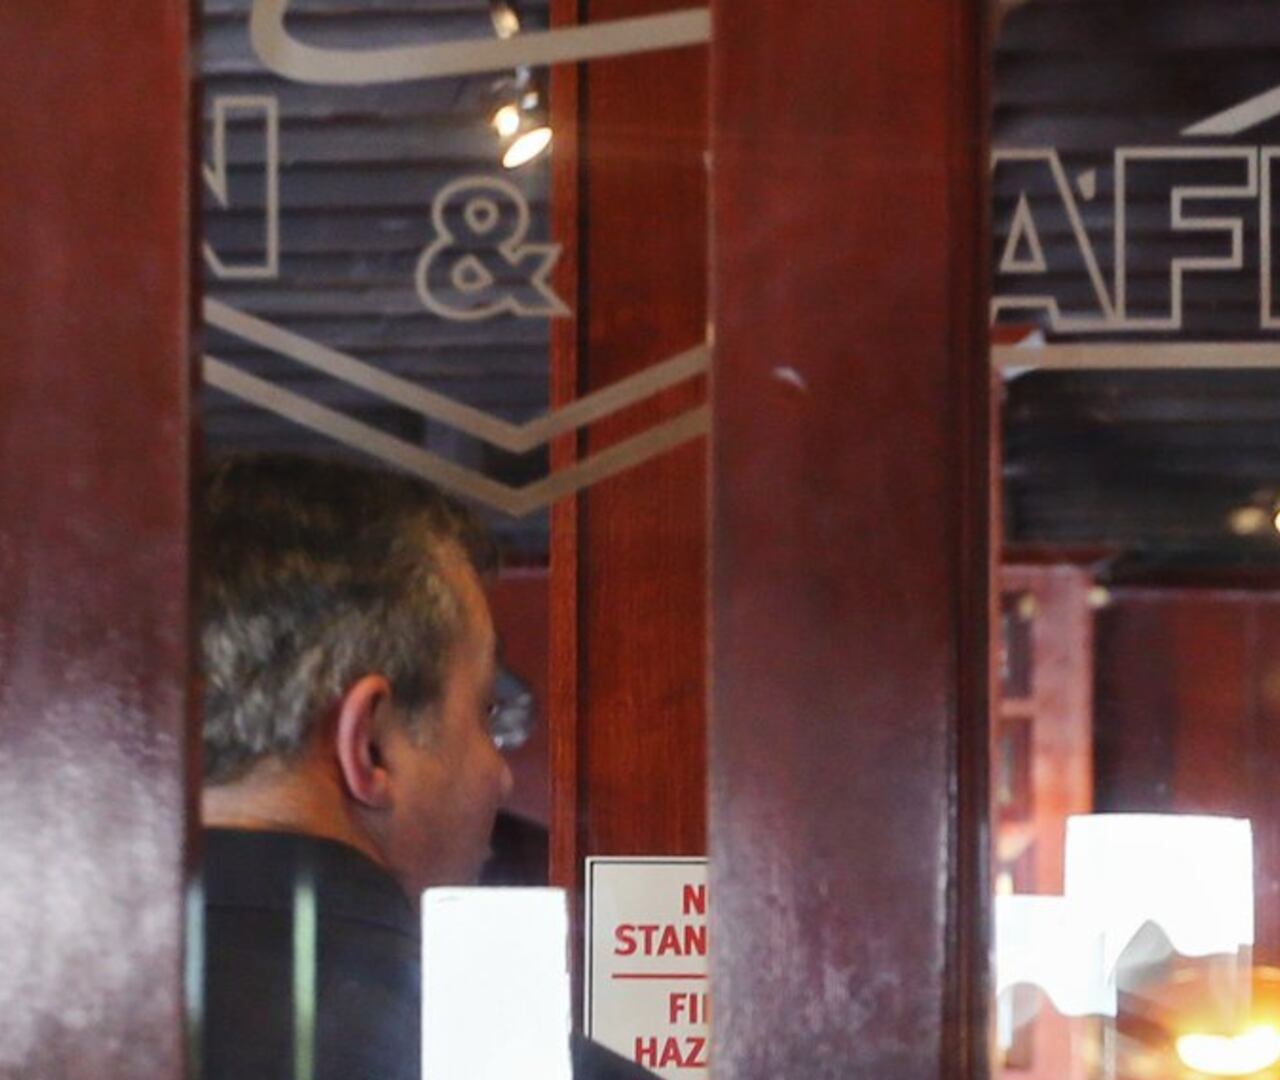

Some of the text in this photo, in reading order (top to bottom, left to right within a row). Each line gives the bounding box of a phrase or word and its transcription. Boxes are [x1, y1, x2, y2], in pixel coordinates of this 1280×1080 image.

[416, 175, 571, 322] &
[682, 884, 706, 916] N
[614, 924, 707, 956] STAN
[669, 993, 708, 1024] FI
[635, 1036, 707, 1069] HAZ
